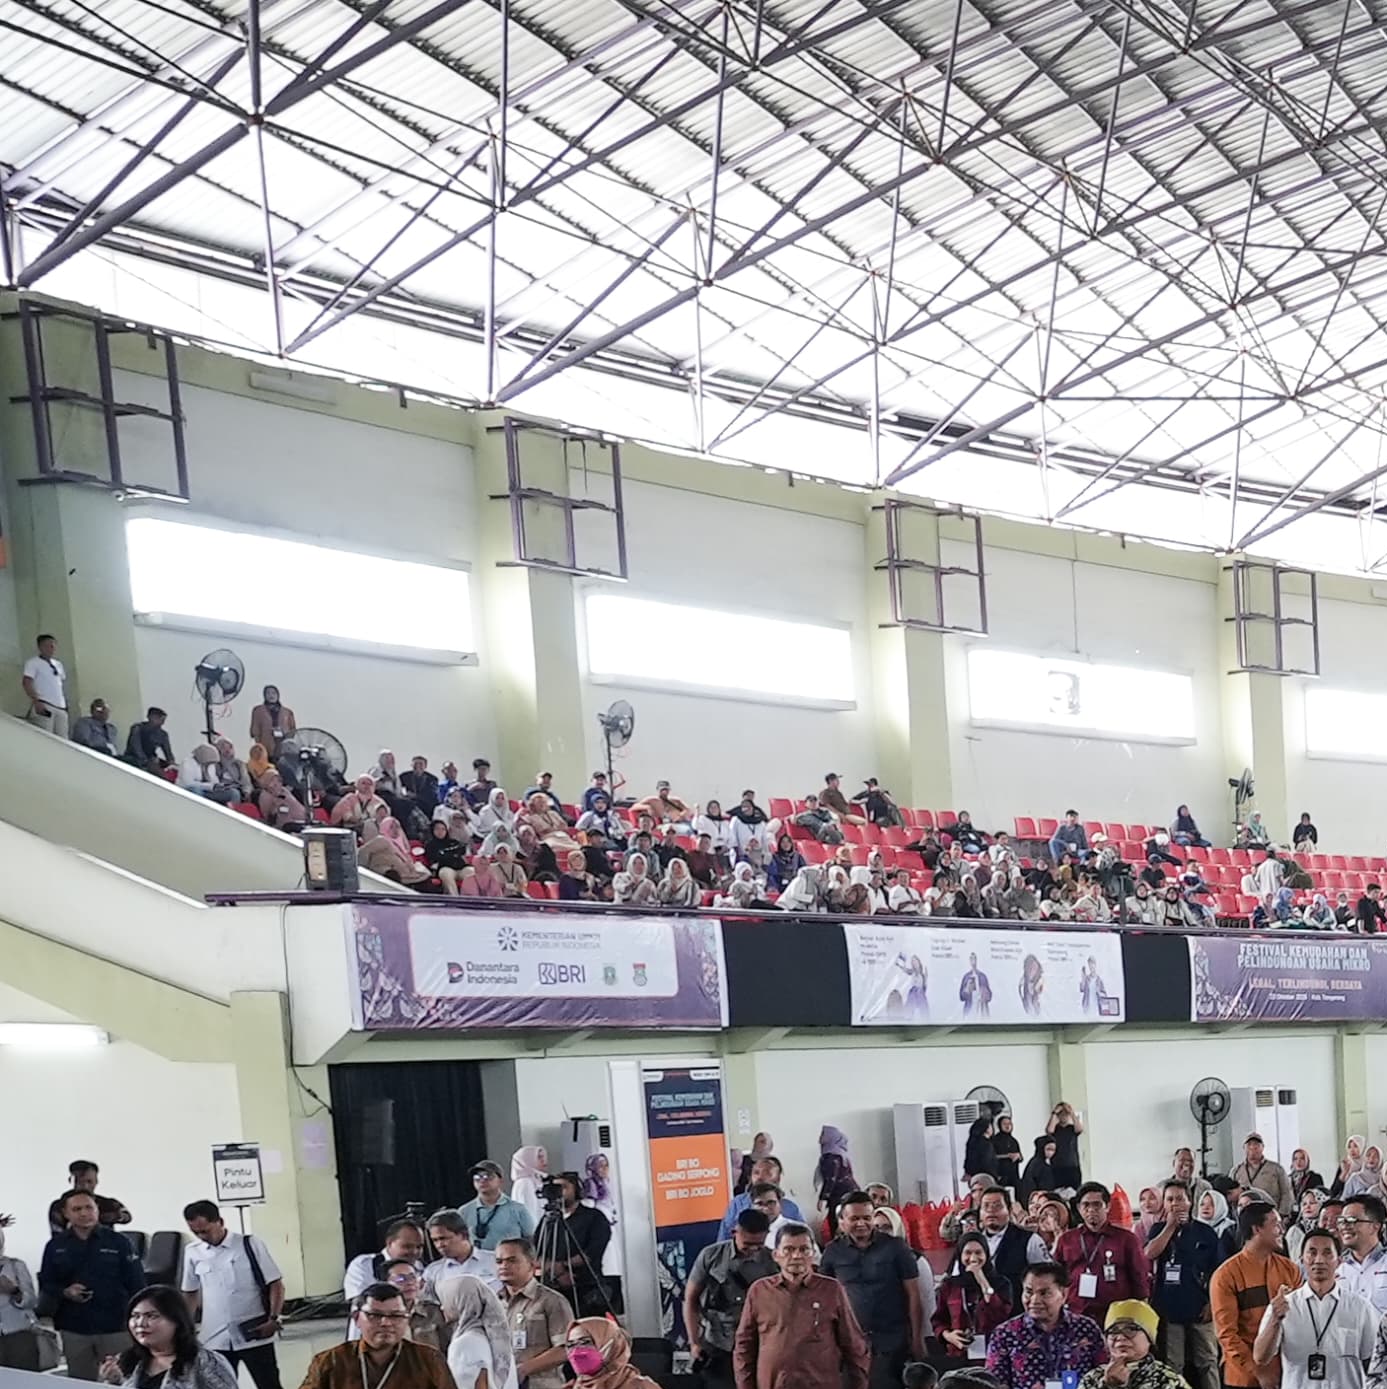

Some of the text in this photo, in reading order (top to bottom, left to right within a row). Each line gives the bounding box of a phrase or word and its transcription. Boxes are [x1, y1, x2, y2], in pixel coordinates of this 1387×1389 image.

[1239, 943, 1367, 959] FESTIVAL KEMUDAHAN DAN
[466, 961, 520, 972] Danantara
[1238, 956, 1371, 971] PELINDUNGAN USAHA MIKRO
[467, 973, 518, 985] Indonesia
[558, 965, 587, 983] BRI
[223, 1168, 252, 1177] Pintu
[221, 1180, 257, 1190] Keluar
